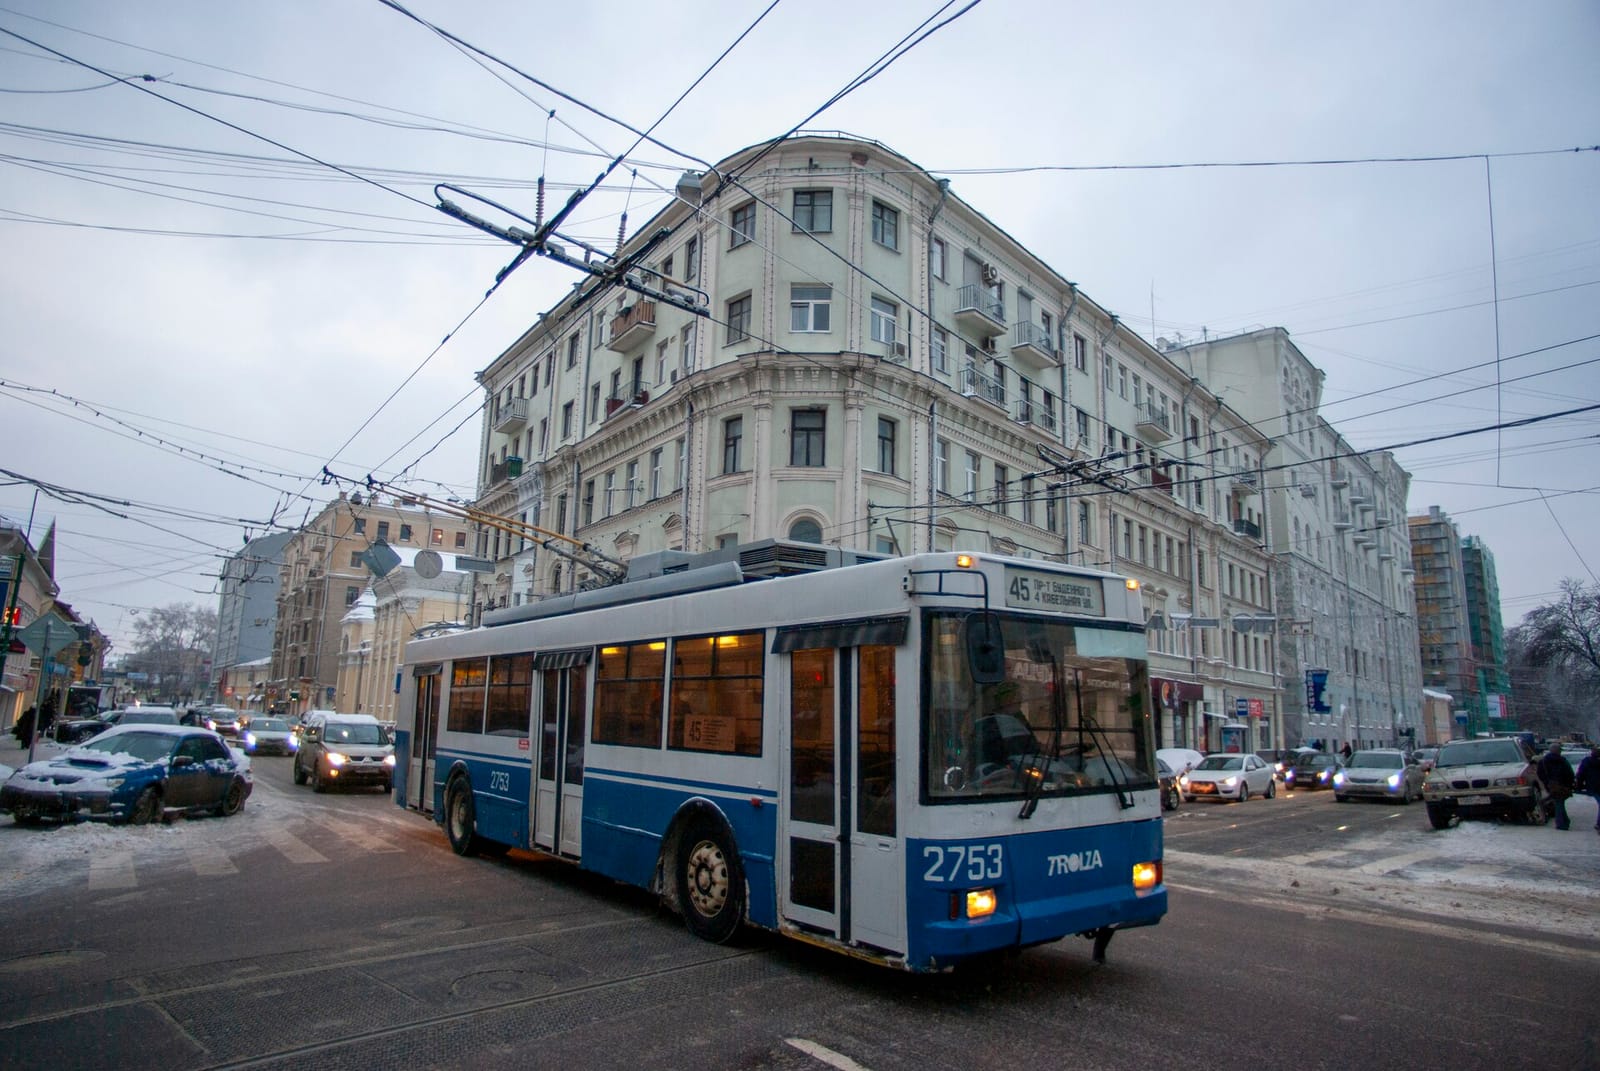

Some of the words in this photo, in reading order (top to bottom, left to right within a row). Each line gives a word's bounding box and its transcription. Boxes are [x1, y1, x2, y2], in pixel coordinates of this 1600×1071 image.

[1009, 575, 1030, 602] 45
[688, 720, 702, 743] 45
[489, 770, 510, 792] 2753
[922, 843, 1003, 883] 2753
